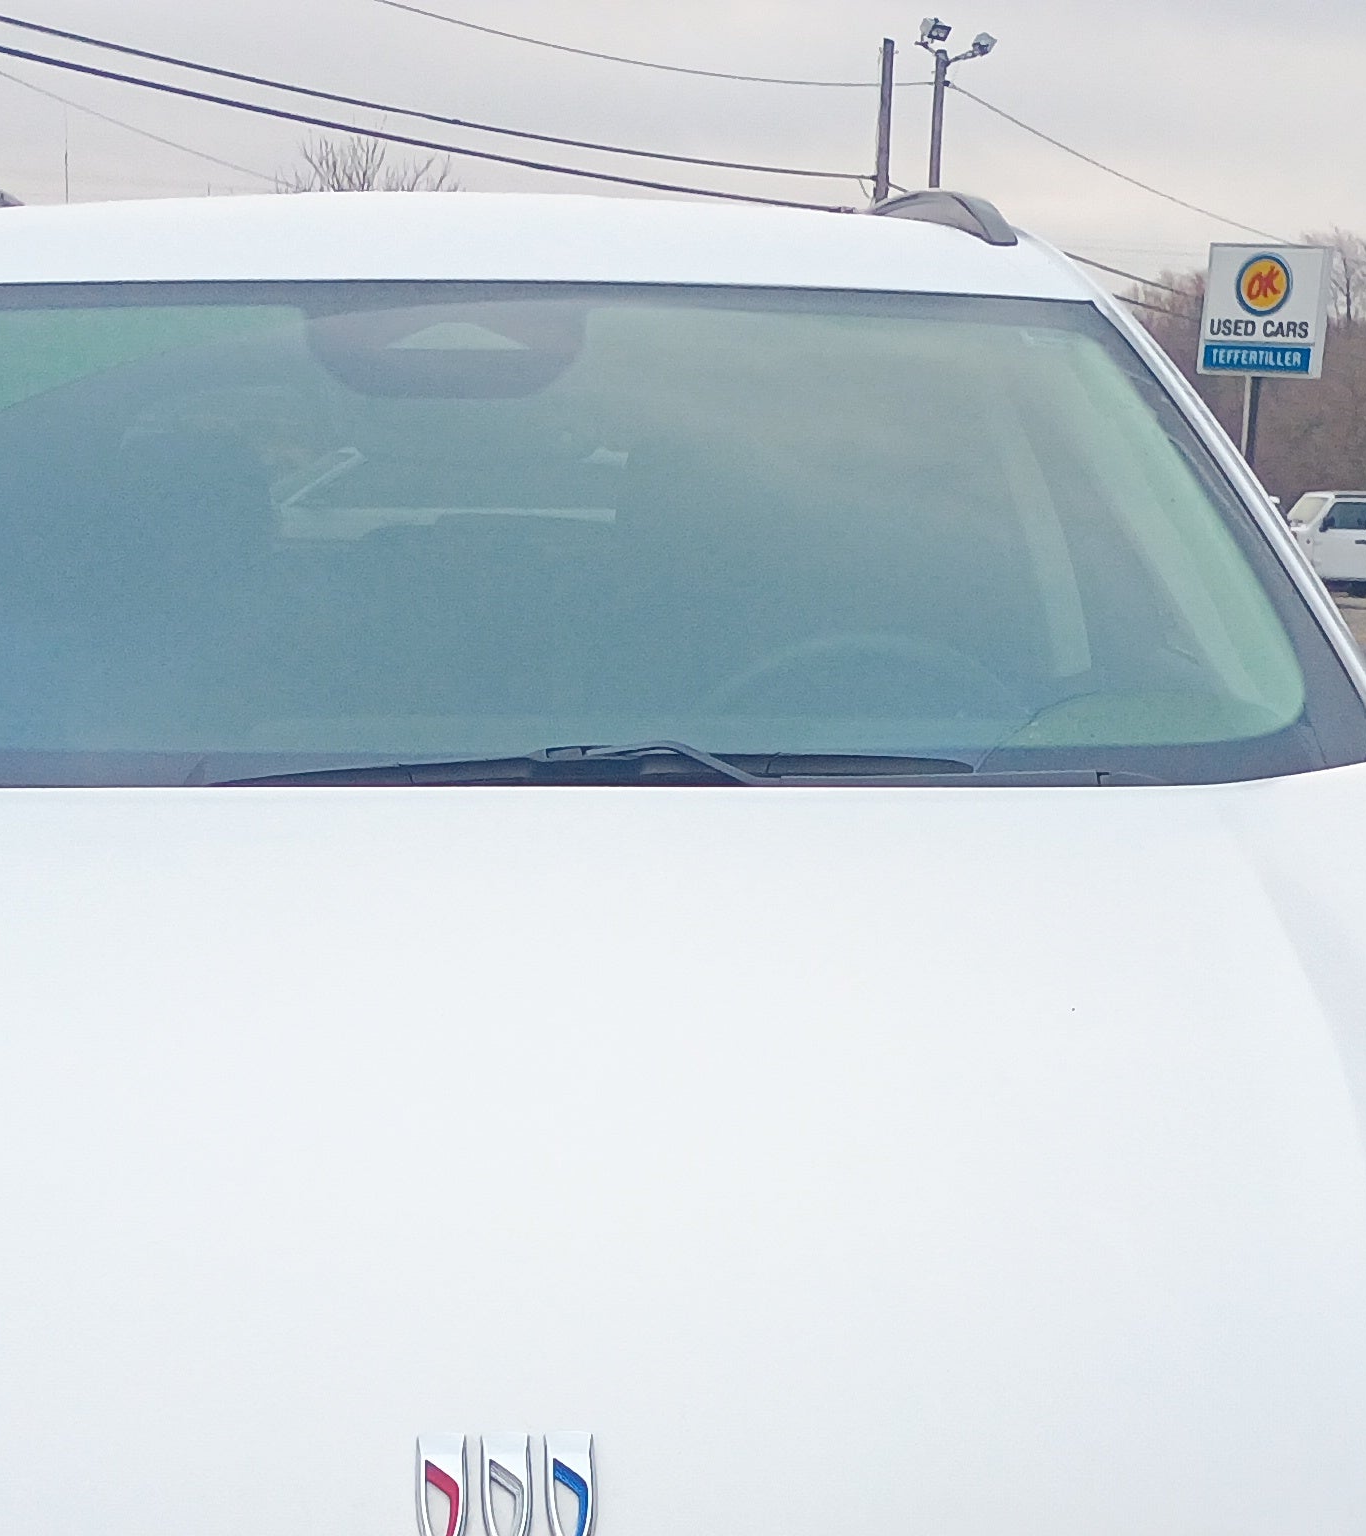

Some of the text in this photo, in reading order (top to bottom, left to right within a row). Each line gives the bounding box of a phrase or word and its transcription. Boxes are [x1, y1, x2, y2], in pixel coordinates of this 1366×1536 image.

[1247, 266, 1281, 300] OK
[1210, 319, 1309, 339] USED CARS
[1212, 348, 1302, 367] TEFFERTILLER
